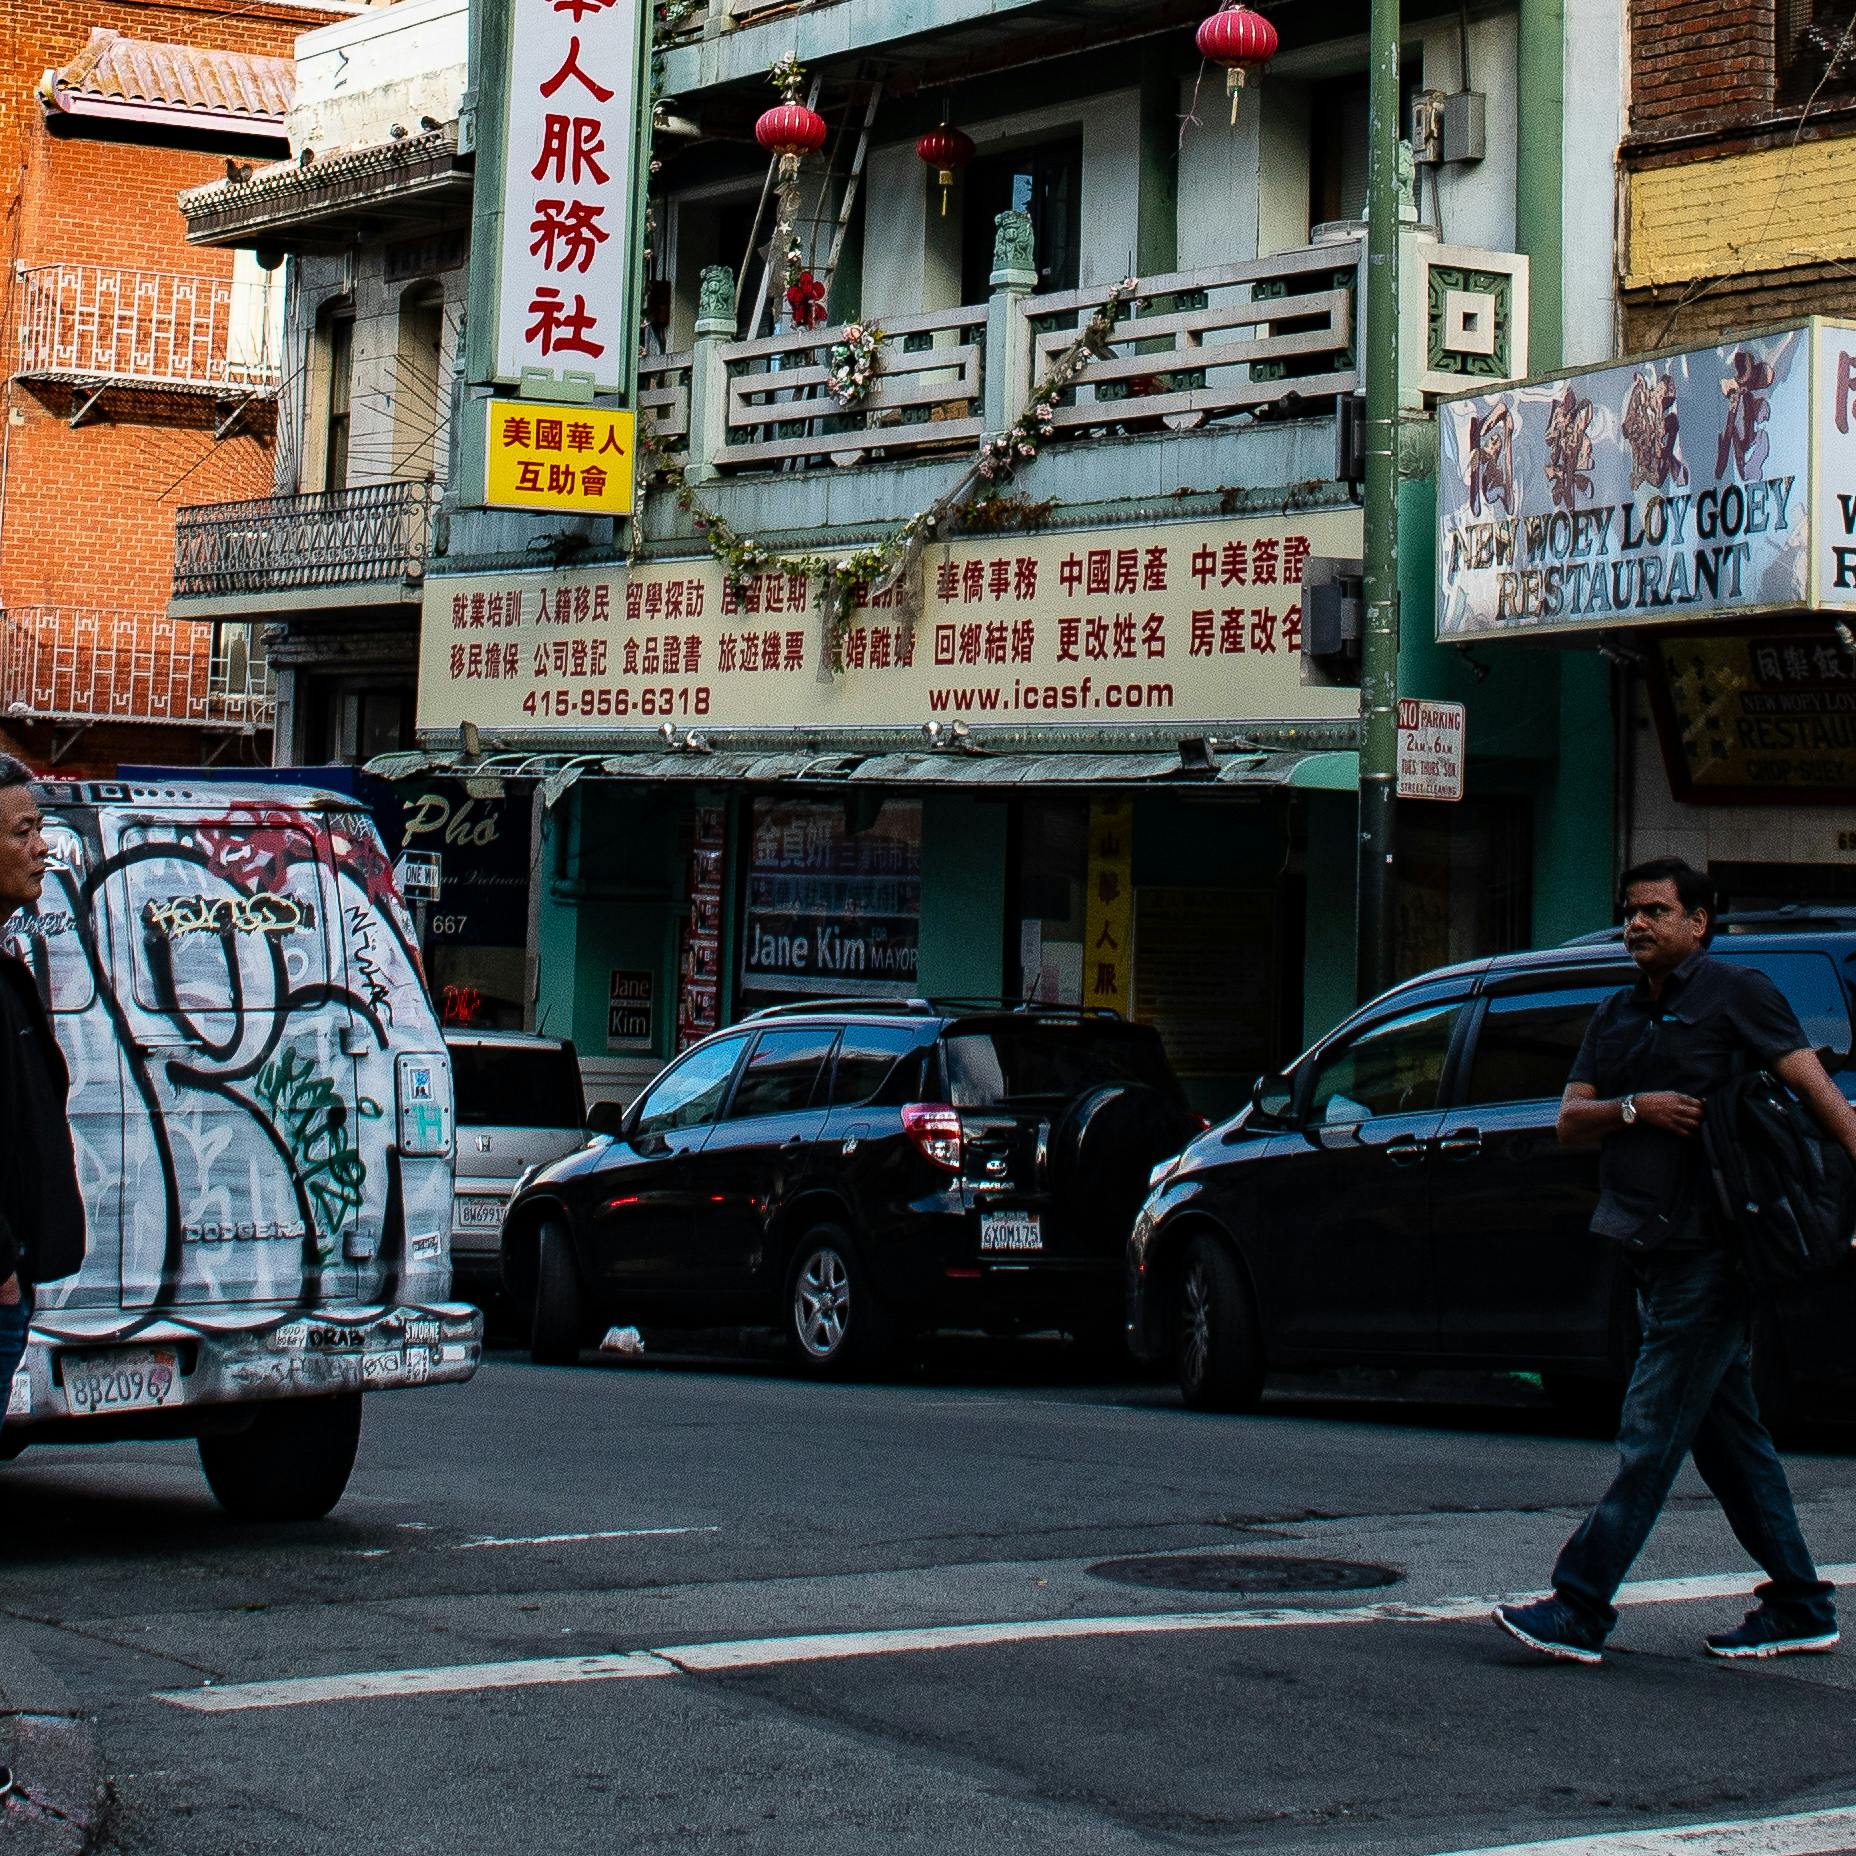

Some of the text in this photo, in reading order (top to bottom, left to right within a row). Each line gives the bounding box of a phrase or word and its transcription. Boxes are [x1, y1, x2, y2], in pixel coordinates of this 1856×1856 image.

[503, 417, 625, 456] 美國華人
[515, 460, 607, 496] 互助會
[1449, 475, 1796, 573] NEW WOEY LOY GOEY
[451, 589, 522, 630] 就業培訓
[625, 579, 705, 620] 留學探訪
[936, 556, 1038, 604] 華僑事務
[1059, 546, 1169, 598] 中國房產
[1496, 542, 1751, 621] RESTAURANT
[533, 639, 607, 678] 公司登記
[717, 629, 805, 673] 旅遊機票
[1057, 613, 1167, 663] 更改姓名
[1189, 604, 1303, 658] 房產改名
[929, 676, 1174, 712] www.icasf.com
[1398, 702, 1461, 731] NO PARKING
[406, 865, 422, 884] ONE
[432, 915, 468, 934] 667
[750, 923, 809, 968] Jane
[816, 924, 866, 971] Kim
[612, 973, 650, 998] Jane
[611, 1008, 647, 1035] Kim
[72, 1365, 175, 1408] 8B20969
